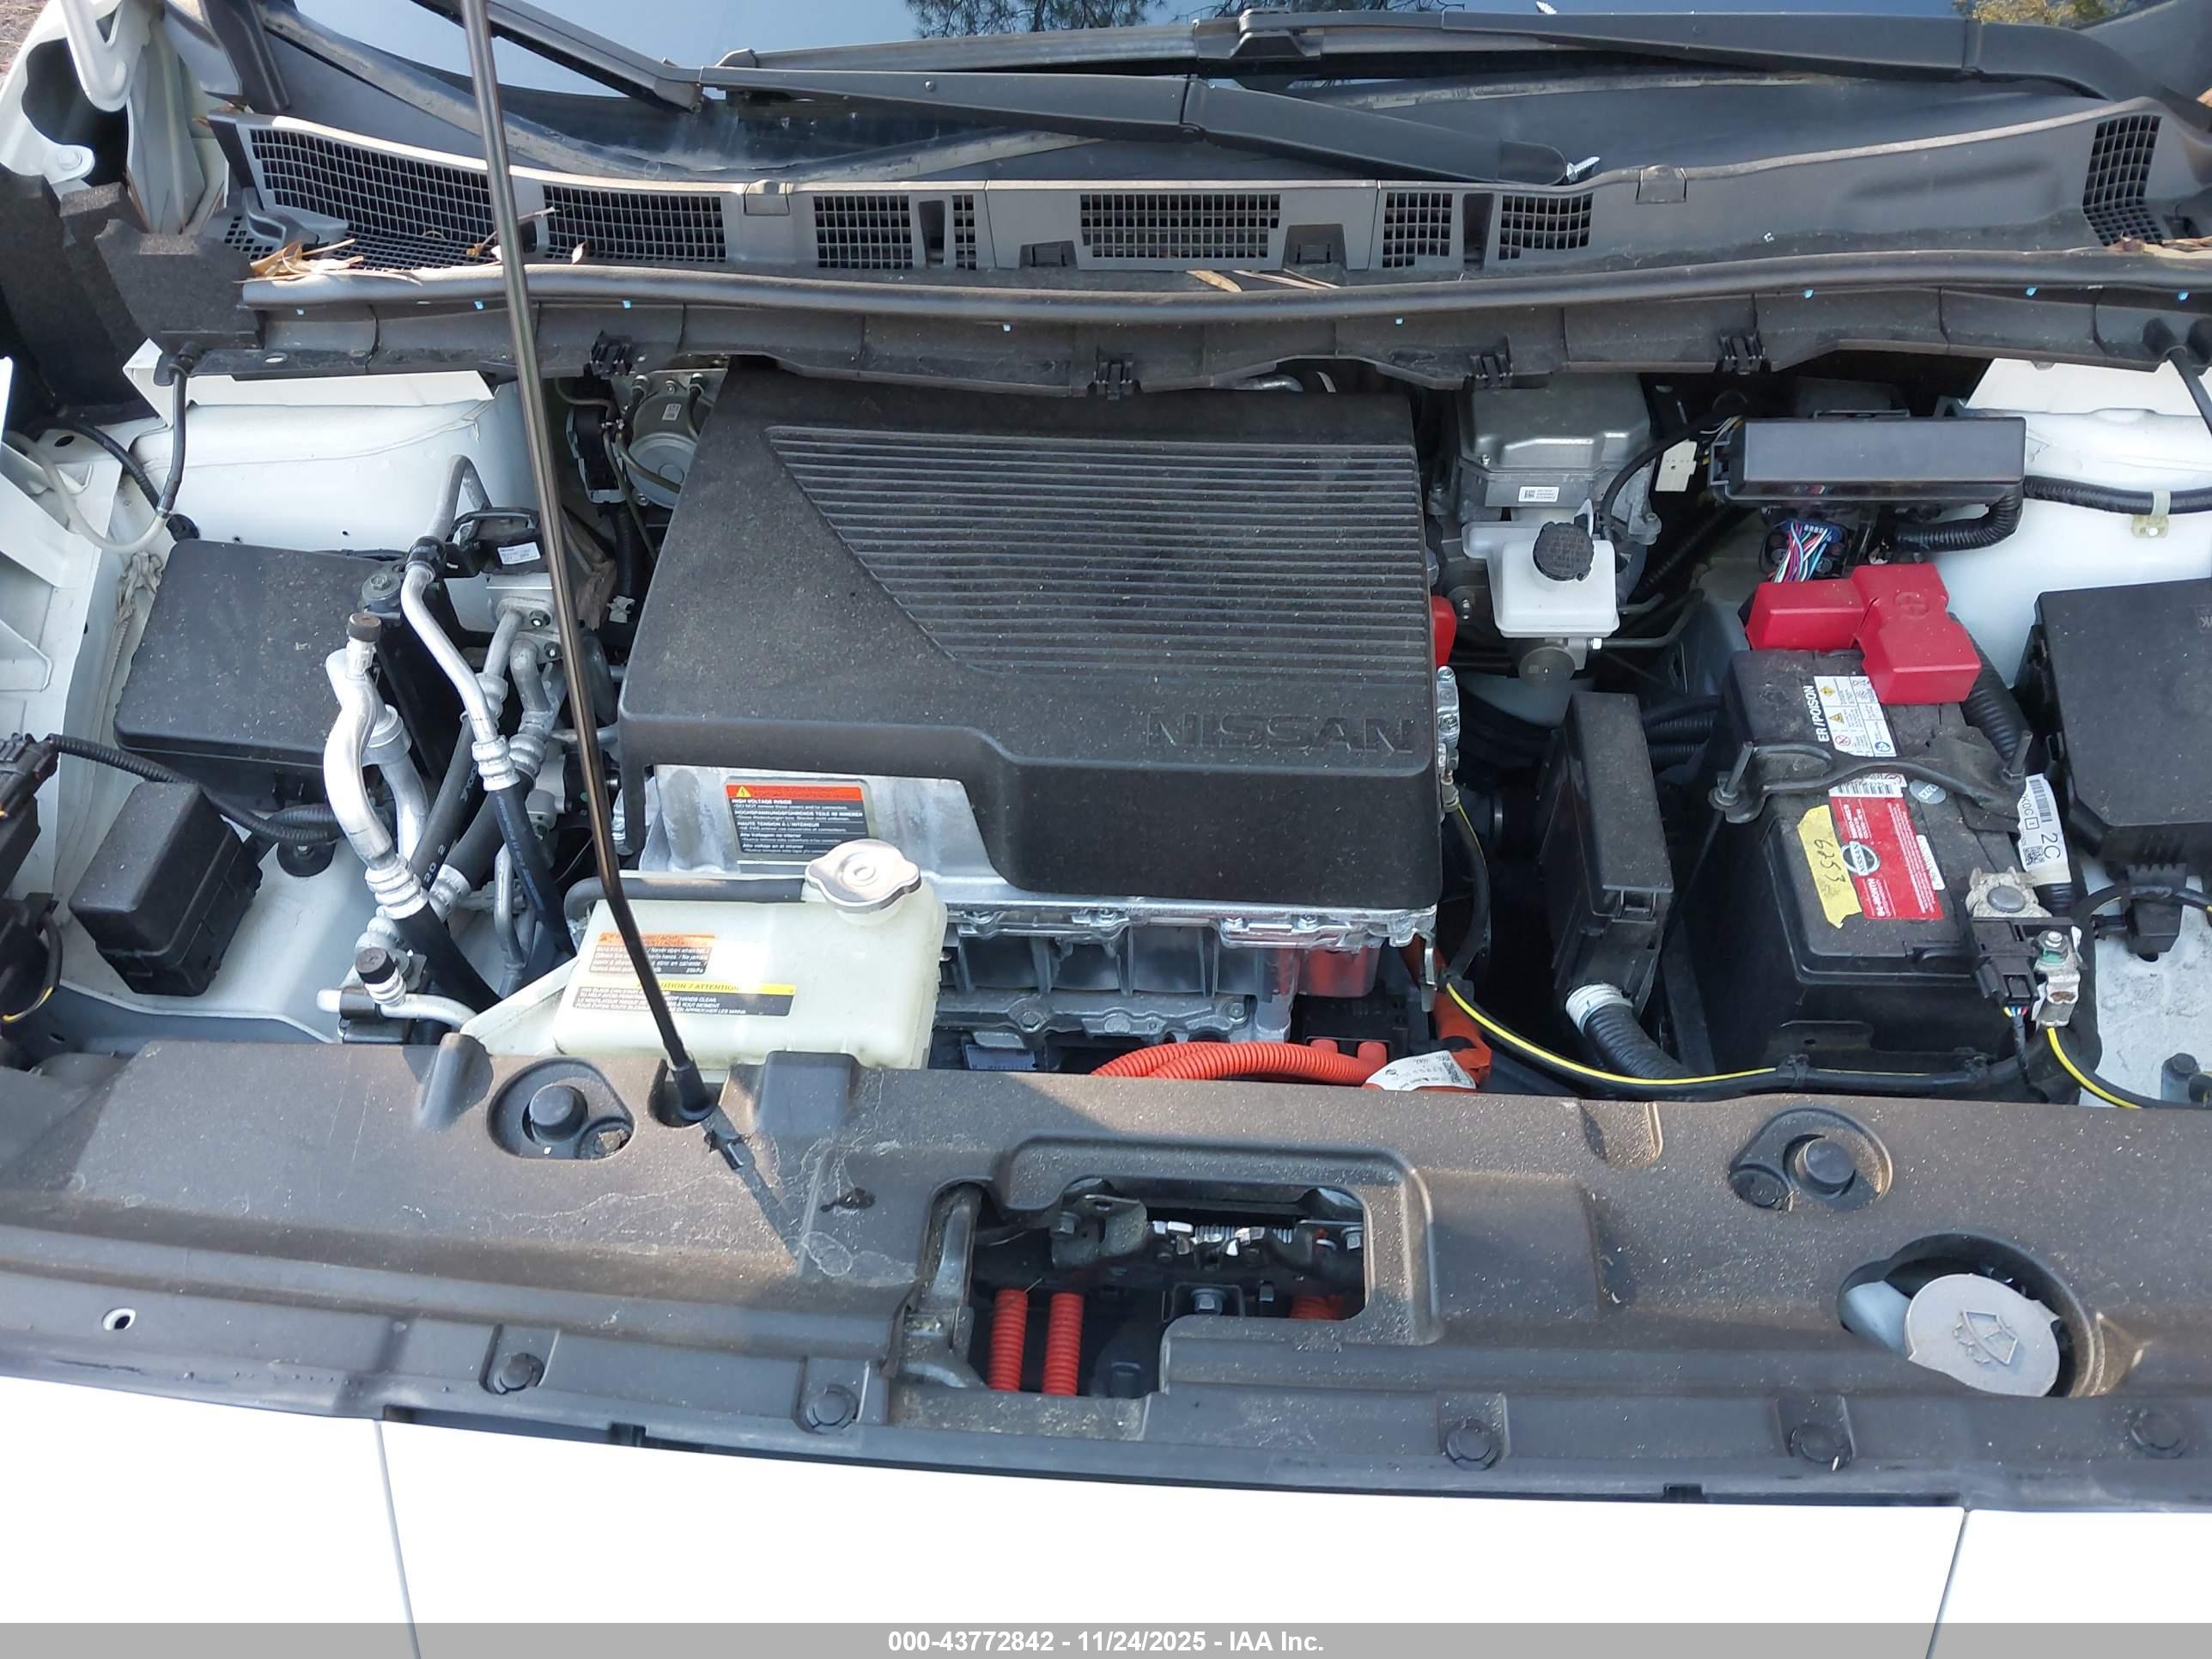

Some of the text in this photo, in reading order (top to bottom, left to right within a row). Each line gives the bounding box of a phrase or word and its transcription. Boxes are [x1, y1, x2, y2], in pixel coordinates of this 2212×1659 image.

[1146, 711, 1413, 754] NISSAN
[1850, 842, 1868, 874] NISSAN
[2041, 832, 2061, 860] 2C
[423, 861, 437, 884] 20
